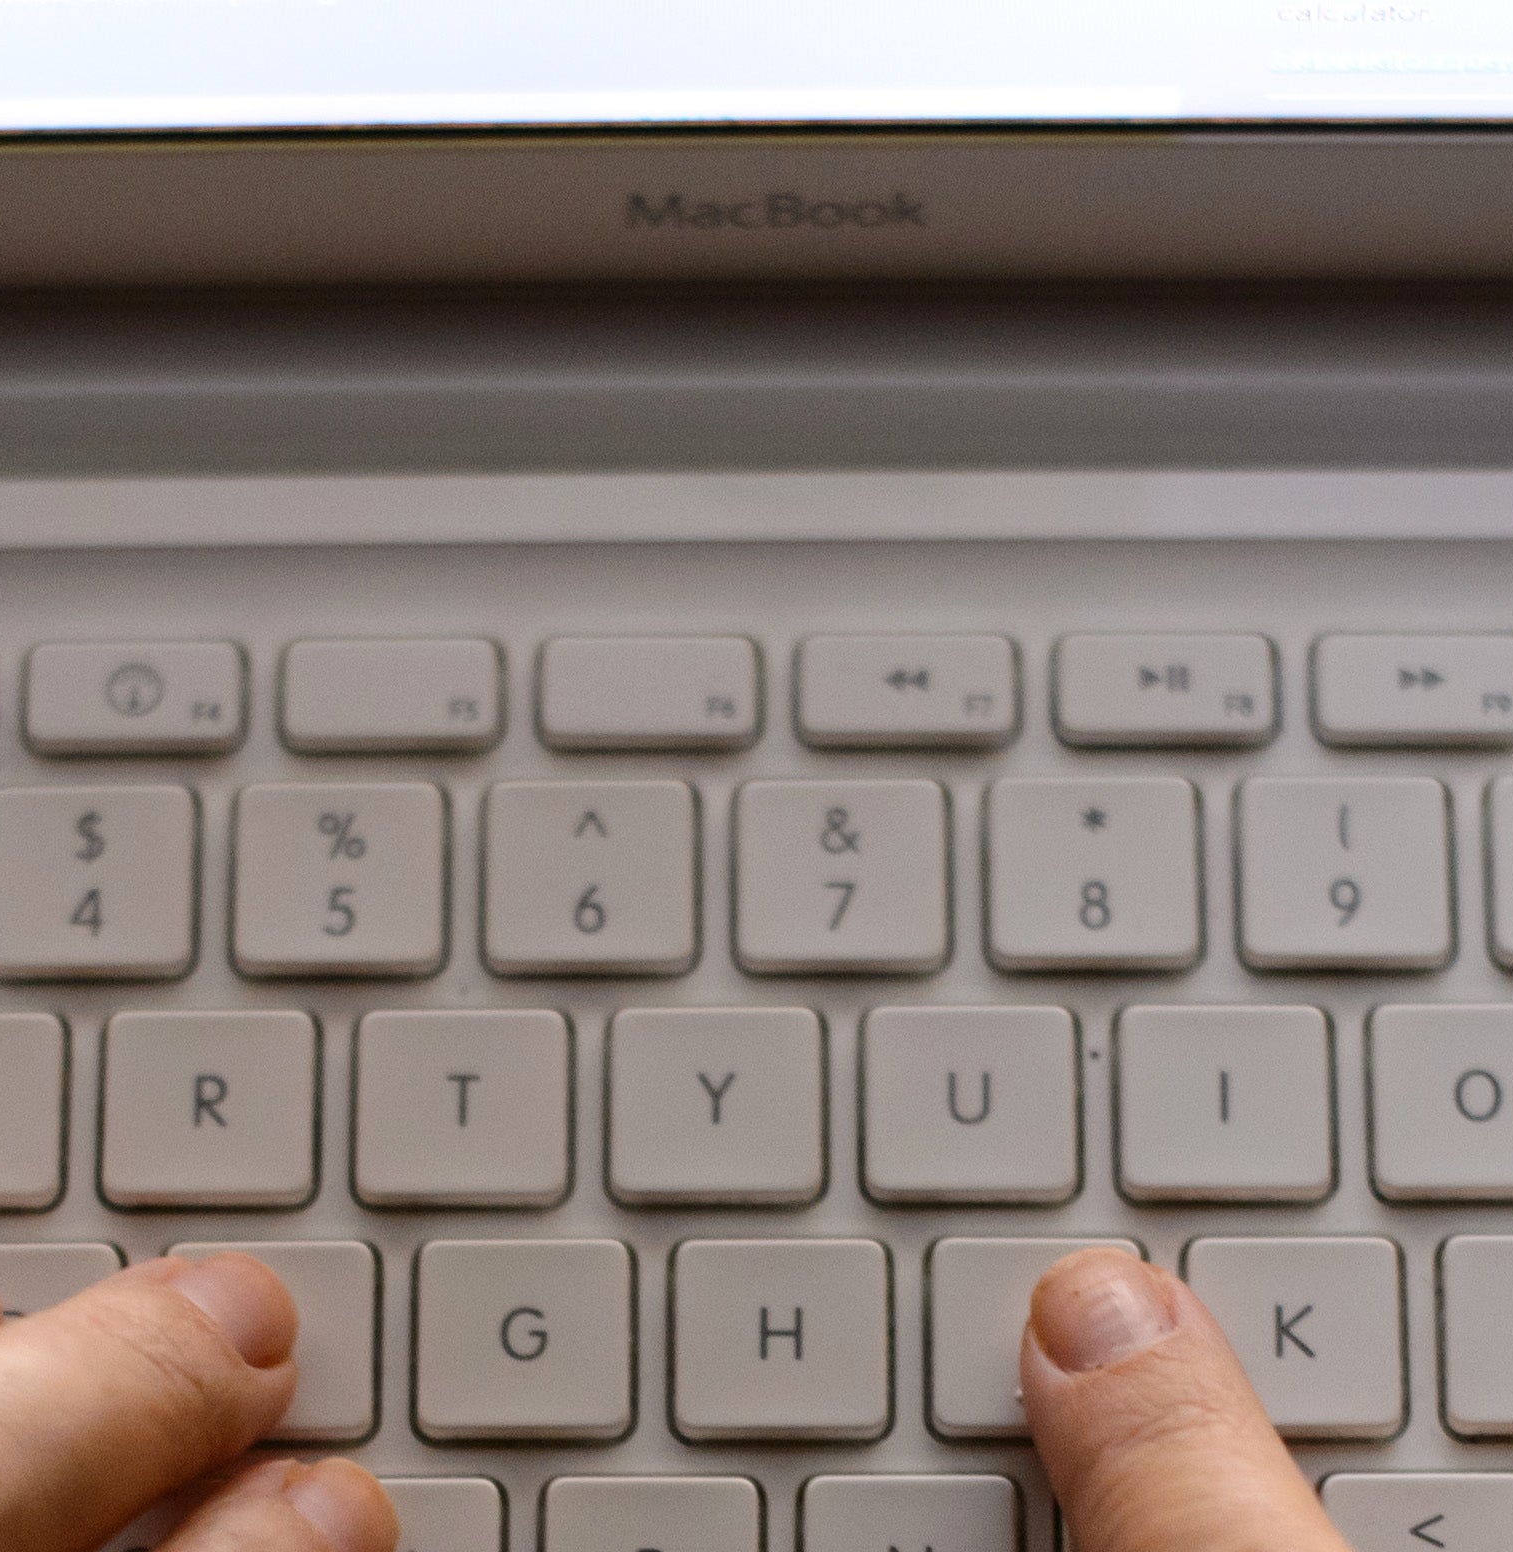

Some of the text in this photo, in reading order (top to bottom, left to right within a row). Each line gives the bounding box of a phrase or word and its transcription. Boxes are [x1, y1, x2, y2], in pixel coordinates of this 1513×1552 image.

[624, 193, 927, 230] MacBook
[191, 702, 221, 722] F4
[448, 697, 479, 721] F5
[75, 809, 105, 863] $
[316, 810, 367, 860] %
[820, 805, 860, 855] &
[1335, 802, 1352, 852] (
[69, 887, 103, 935] 4
[323, 884, 357, 937] 5
[573, 885, 607, 934] 6
[824, 879, 858, 931] 7
[1078, 879, 1112, 930] 8
[1328, 877, 1363, 926] 9
[193, 1074, 228, 1127] R
[447, 1072, 480, 1127] T
[697, 1072, 736, 1125] Y
[946, 1071, 992, 1126] U
[1217, 1069, 1231, 1124] I
[1453, 1068, 1504, 1123] O
[499, 1305, 549, 1362] G
[759, 1306, 804, 1360] H
[1274, 1304, 1315, 1358] K
[1409, 1514, 1445, 1549] <
